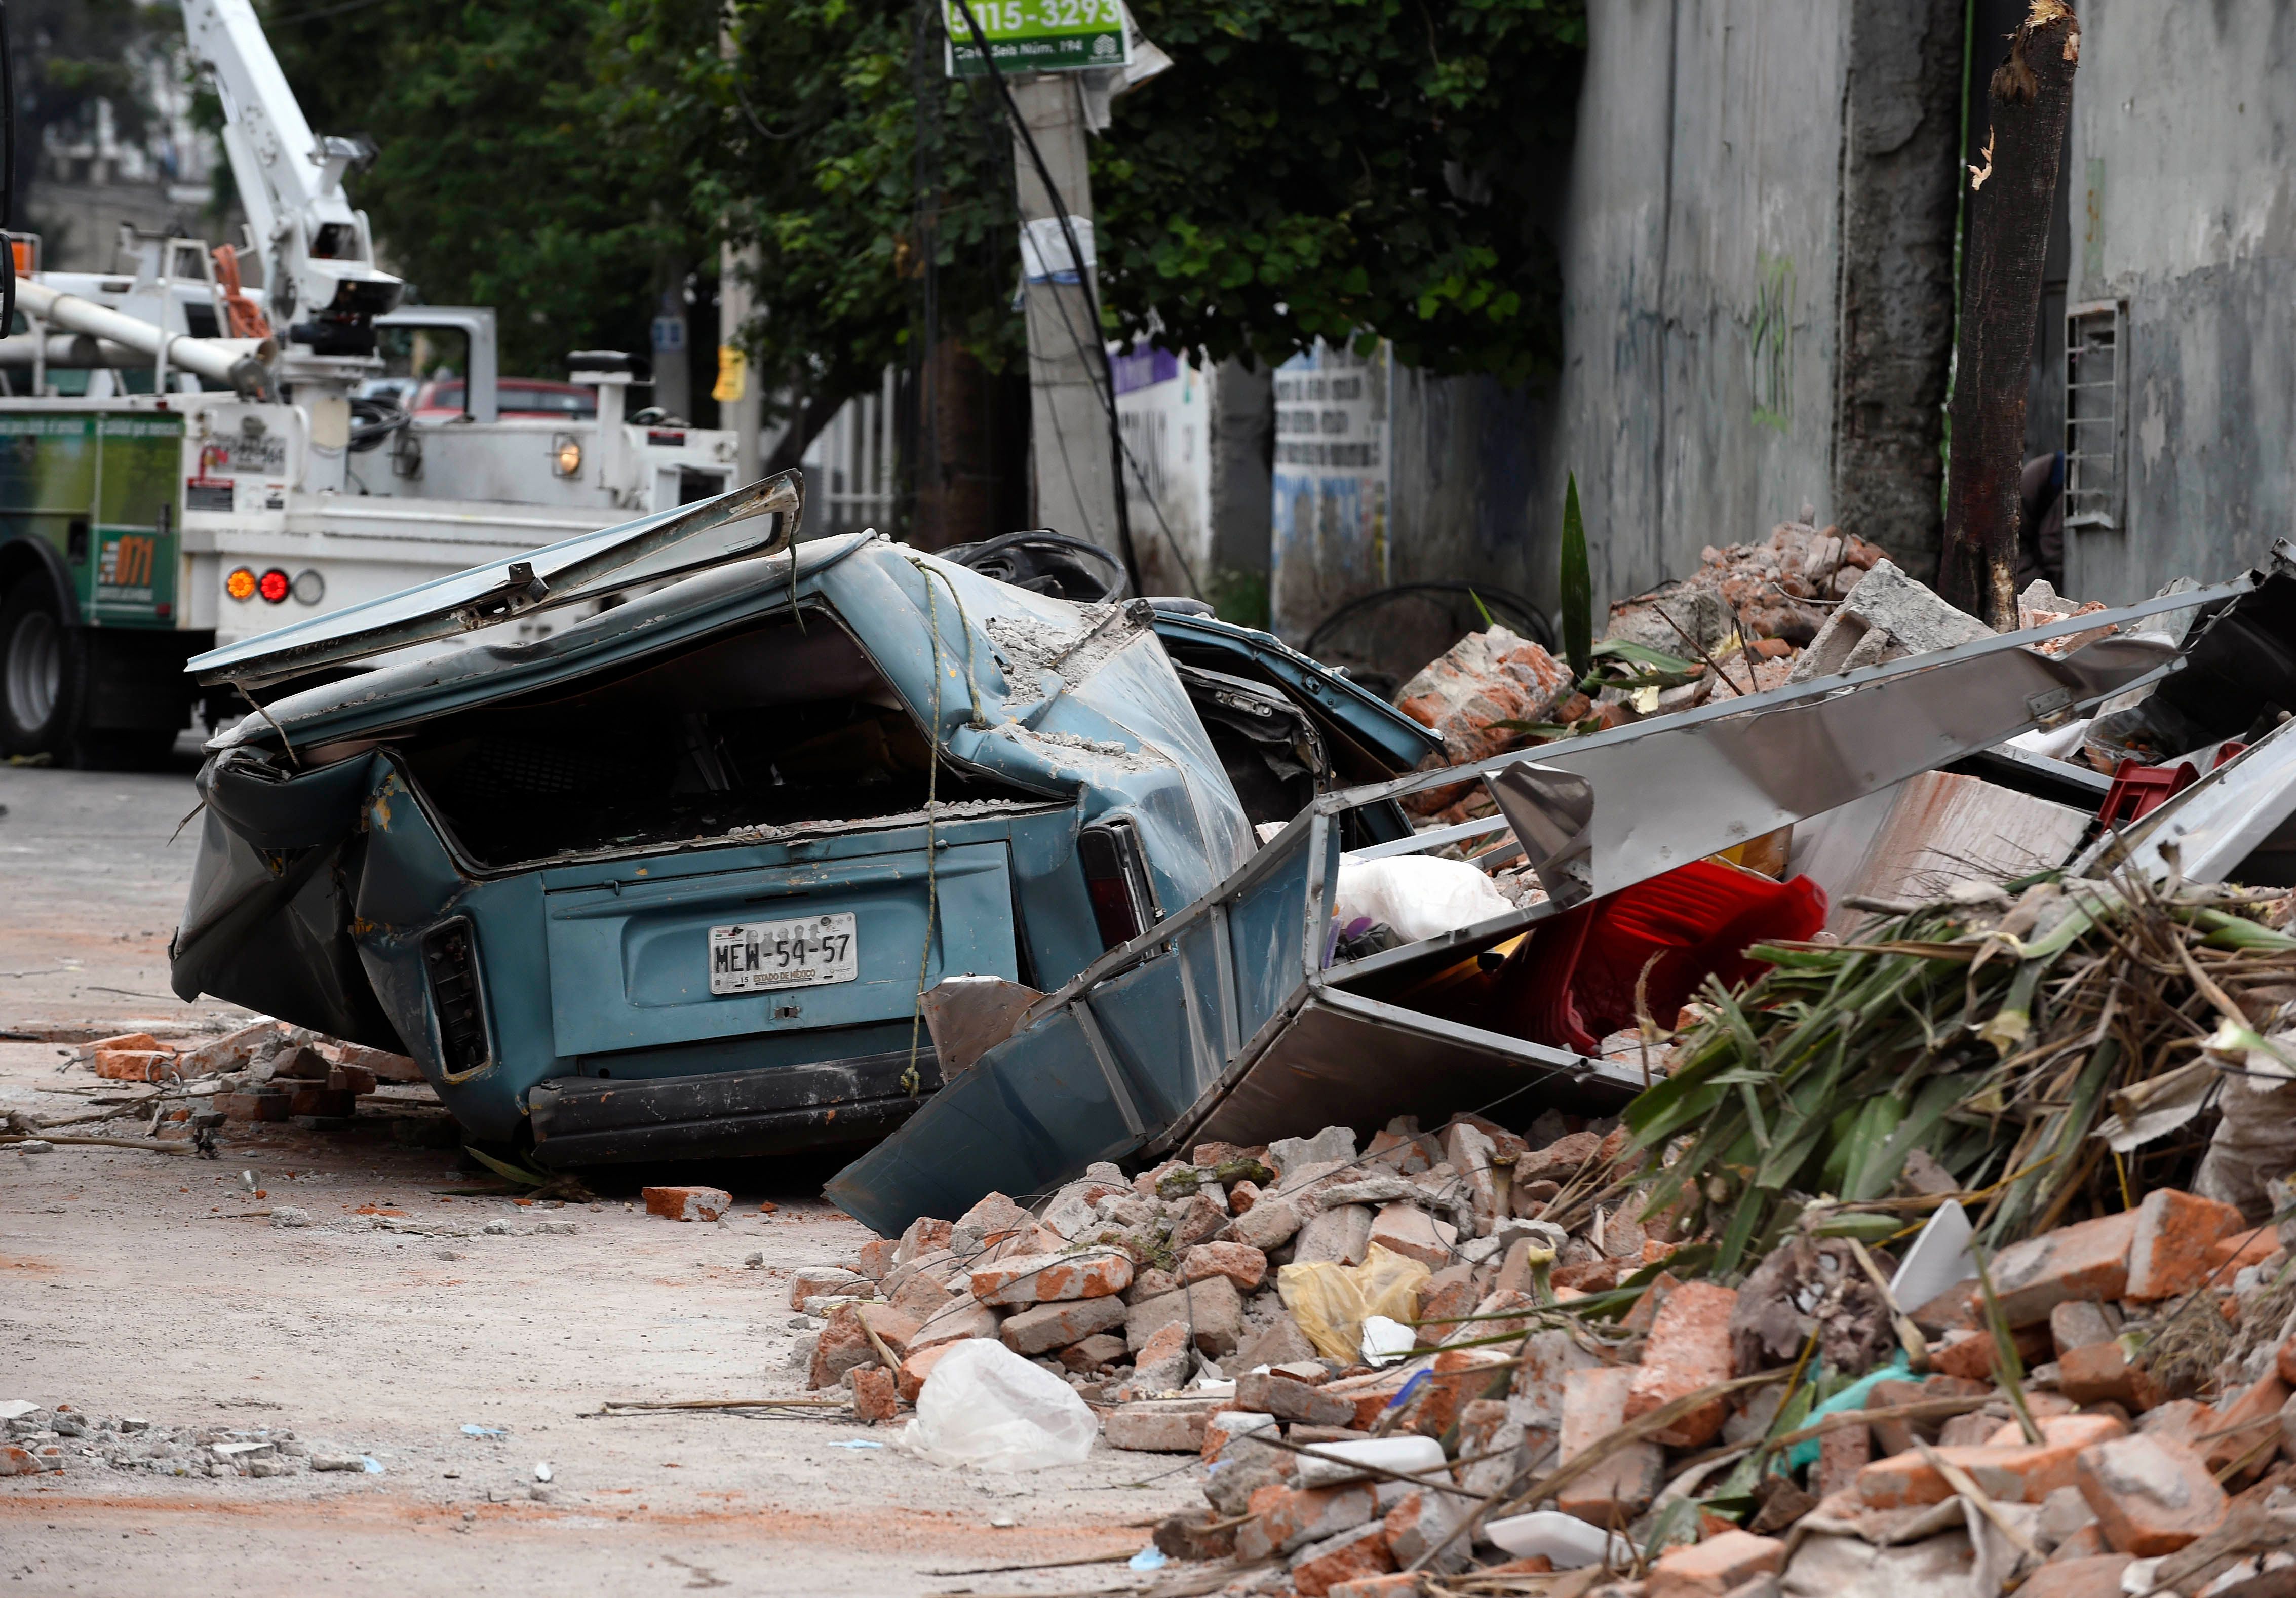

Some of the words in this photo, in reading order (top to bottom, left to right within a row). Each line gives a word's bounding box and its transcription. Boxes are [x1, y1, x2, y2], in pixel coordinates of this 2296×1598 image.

[116, 535, 154, 586] 071
[753, 973, 779, 982] ESTADO
[780, 971, 789, 980] DE
[790, 969, 815, 979] MÉXICO
